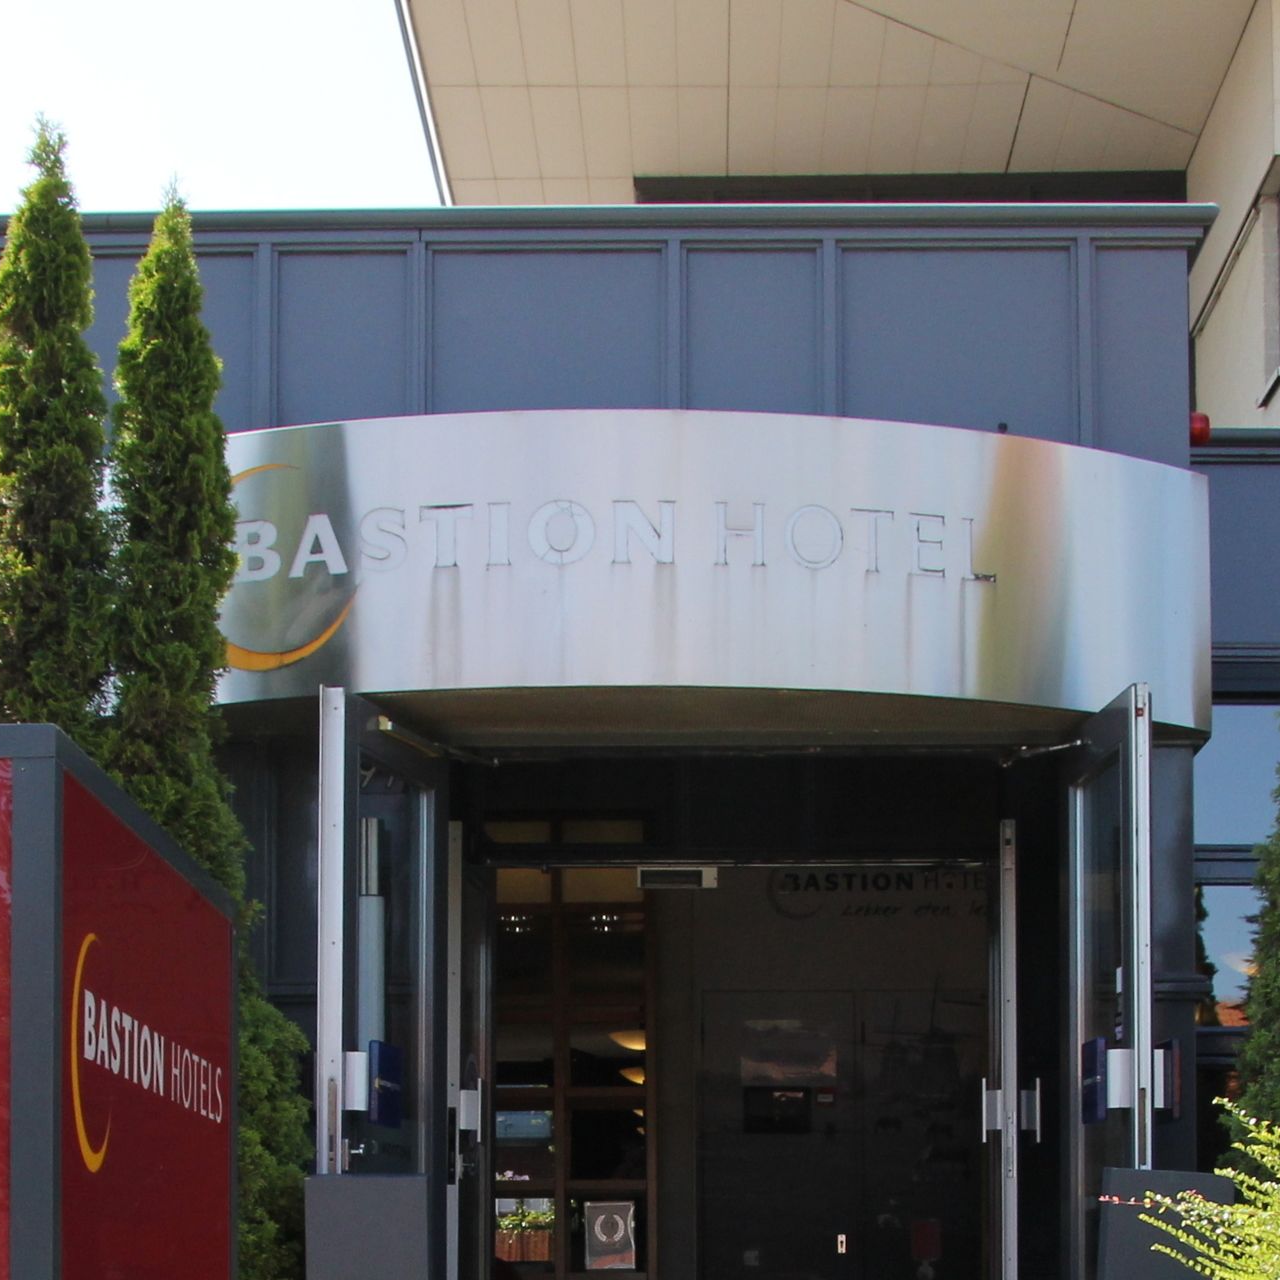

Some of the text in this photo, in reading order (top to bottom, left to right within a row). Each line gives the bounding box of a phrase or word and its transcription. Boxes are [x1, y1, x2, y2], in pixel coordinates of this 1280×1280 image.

[235, 499, 997, 585] BASTION HOTEL
[82, 989, 223, 1124] BASTION HOTELS
